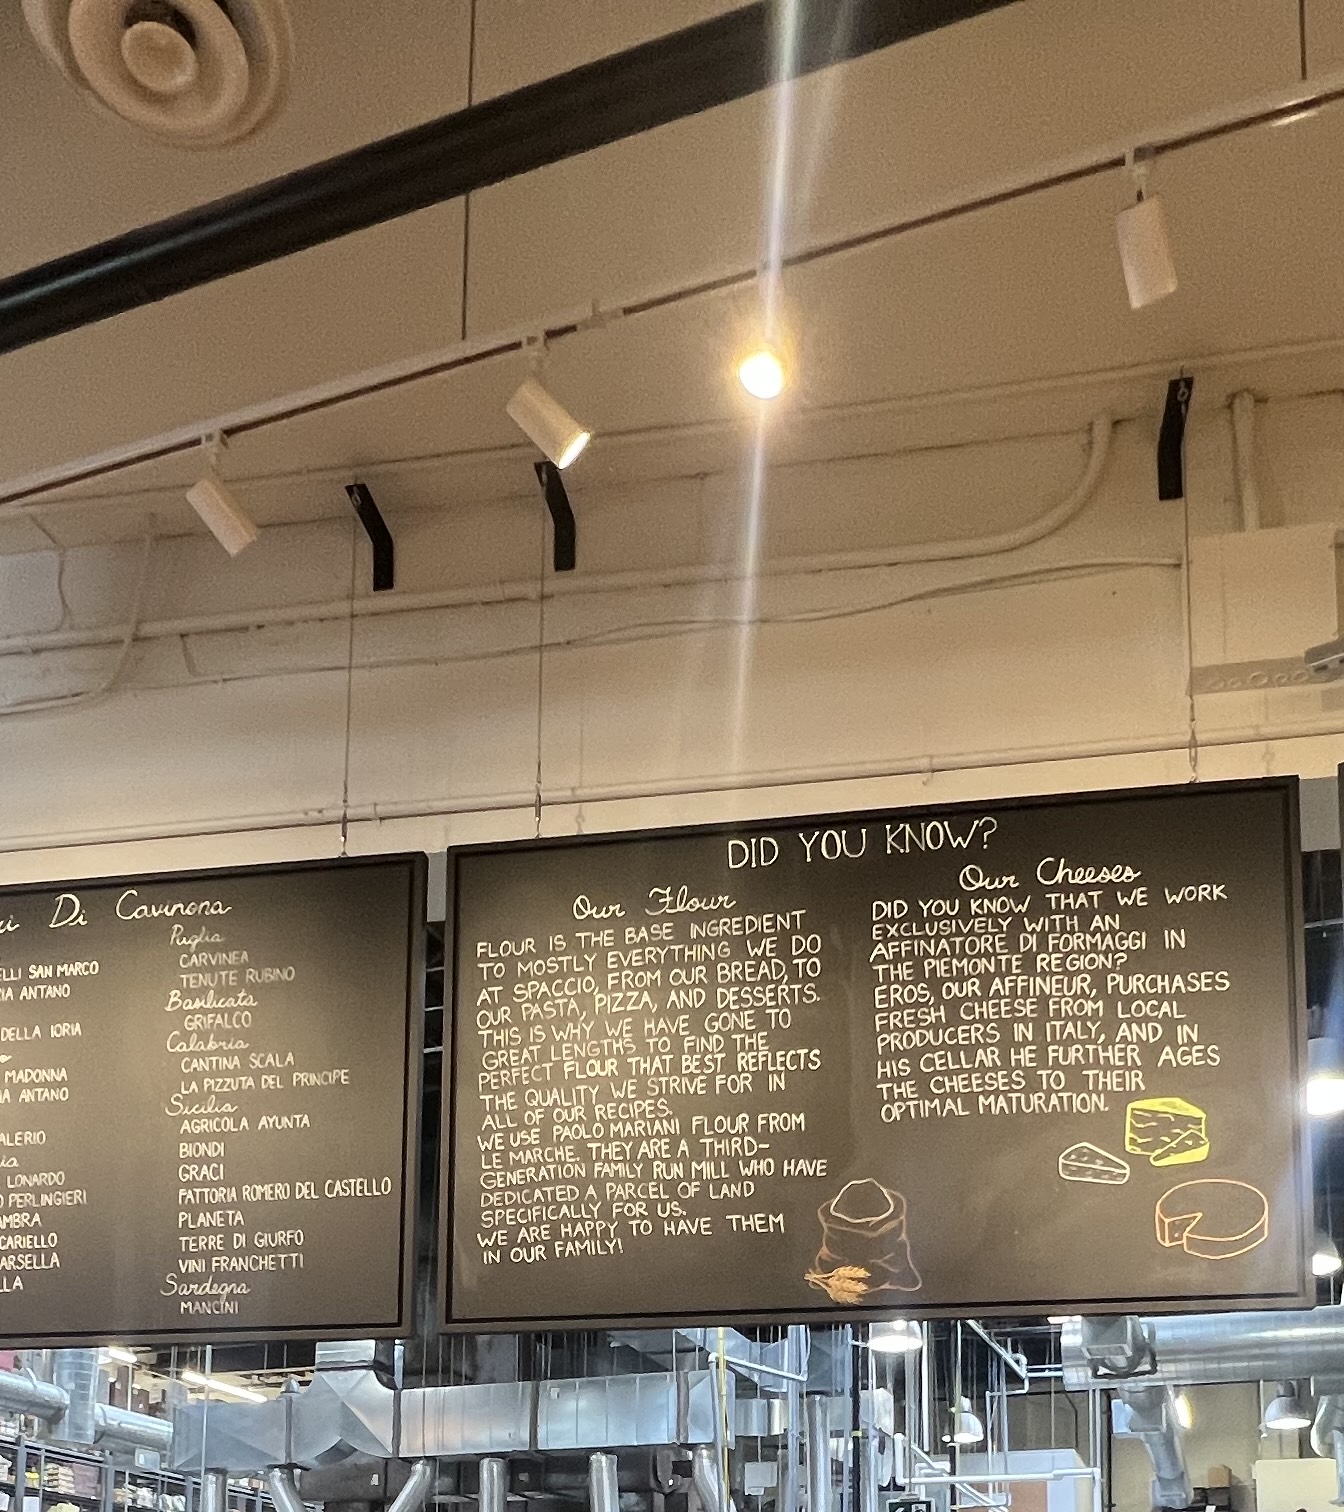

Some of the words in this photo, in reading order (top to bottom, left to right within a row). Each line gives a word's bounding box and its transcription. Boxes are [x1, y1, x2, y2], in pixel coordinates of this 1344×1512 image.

[728, 835, 779, 869] DID
[799, 828, 867, 862] YOU
[886, 816, 998, 854] KNOW?
[958, 865, 1019, 892] Our
[1036, 857, 1141, 885] Cheeses
[49, 894, 88, 928] Di
[573, 895, 626, 921] Our
[645, 885, 736, 916] Flour
[872, 899, 908, 921] DID
[918, 899, 959, 917] YOU
[970, 895, 1031, 915] KNOW
[1045, 891, 1103, 910] THAT
[1116, 887, 1148, 907] WE
[1164, 884, 1228, 904] WORK
[477, 938, 536, 958] FLOUR
[550, 935, 566, 952] IS
[576, 930, 614, 948] THE
[625, 923, 674, 945] BASE
[690, 910, 806, 939] INGREDIENT
[29, 964, 52, 979] SAN
[57, 961, 99, 977] MARCO
[179, 951, 249, 968] CARVINEA
[872, 963, 914, 983] THE
[924, 954, 1022, 979] PIEMONTE
[1036, 952, 1127, 973] REGION?
[20, 984, 71, 1000] ANTANO
[477, 986, 503, 1007] AT
[513, 977, 600, 1003] SPACCIO,
[607, 968, 661, 991] FROM
[669, 966, 708, 985] OUR
[717, 959, 787, 985] BREAD,
[794, 957, 821, 978] TO
[874, 983, 934, 1009] EROS,
[942, 980, 982, 1001] OUR
[989, 974, 1097, 999] AFFINEUR,
[1107, 972, 1230, 995] PURCHASES
[184, 1011, 251, 1031] GRIFALCO
[181, 1055, 240, 1073] CANTINA
[249, 1052, 294, 1069] SCALA
[880, 1098, 969, 1123] OPTIMAL
[978, 1092, 1108, 1115] MATURATION.
[179, 1163, 224, 1181] GRACI
[179, 1211, 244, 1229] PLANETA
[179, 1235, 224, 1252] TERRE
[233, 1233, 246, 1249] DI
[254, 1230, 303, 1248] GIURFO
[483, 1249, 501, 1265] IN
[511, 1244, 547, 1263] OUR
[555, 1238, 624, 1259] FAMILY!
